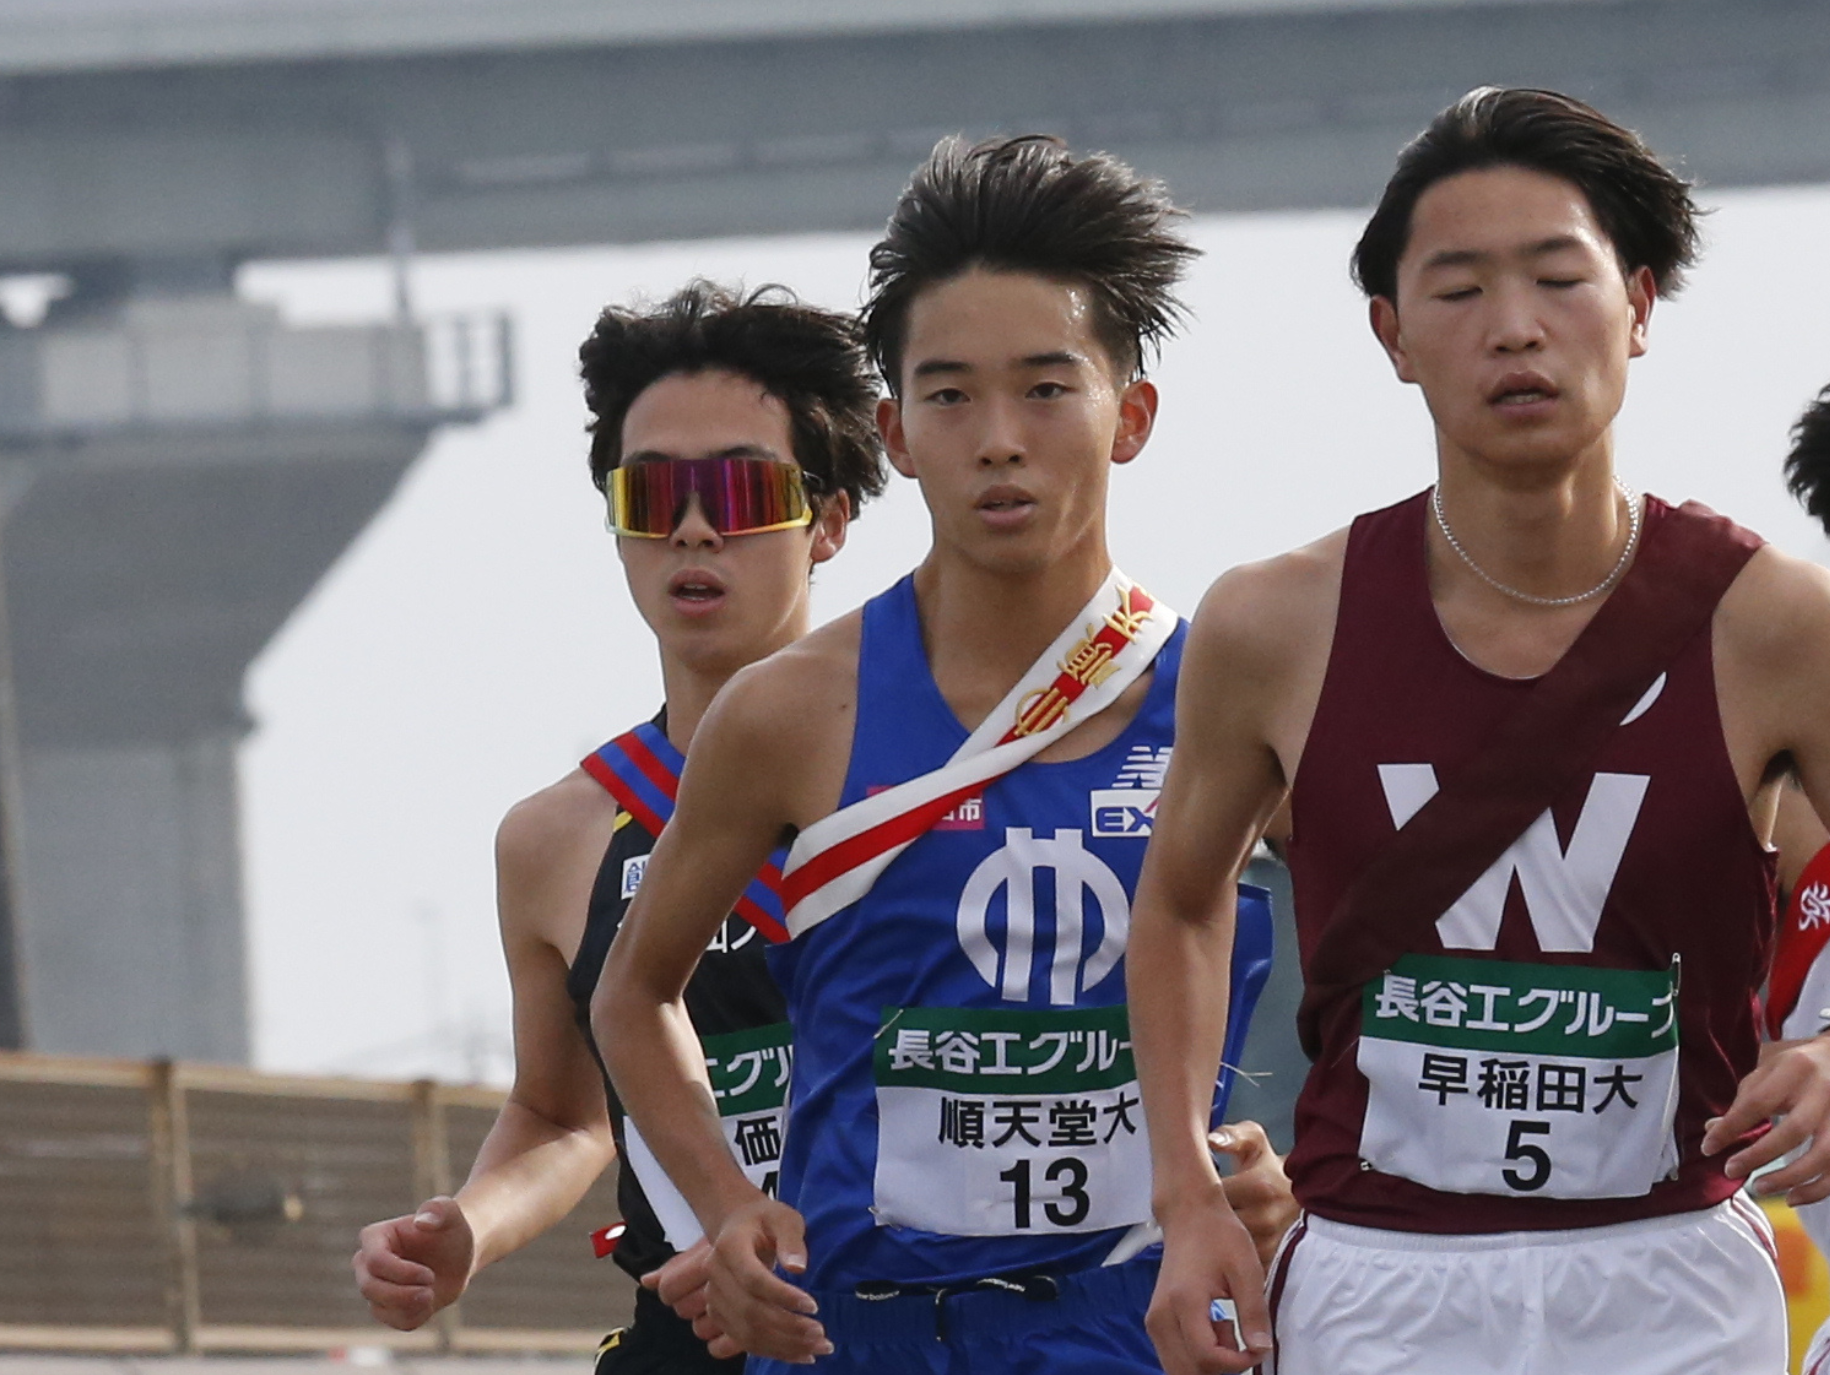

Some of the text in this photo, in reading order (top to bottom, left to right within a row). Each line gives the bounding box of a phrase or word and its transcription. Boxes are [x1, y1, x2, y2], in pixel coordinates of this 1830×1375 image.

[1418, 1053, 1643, 1114] 早稲田大
[938, 1091, 1139, 1149] 順天堂大
[1502, 1120, 1551, 1191] 5
[1000, 1157, 1090, 1228] 13
